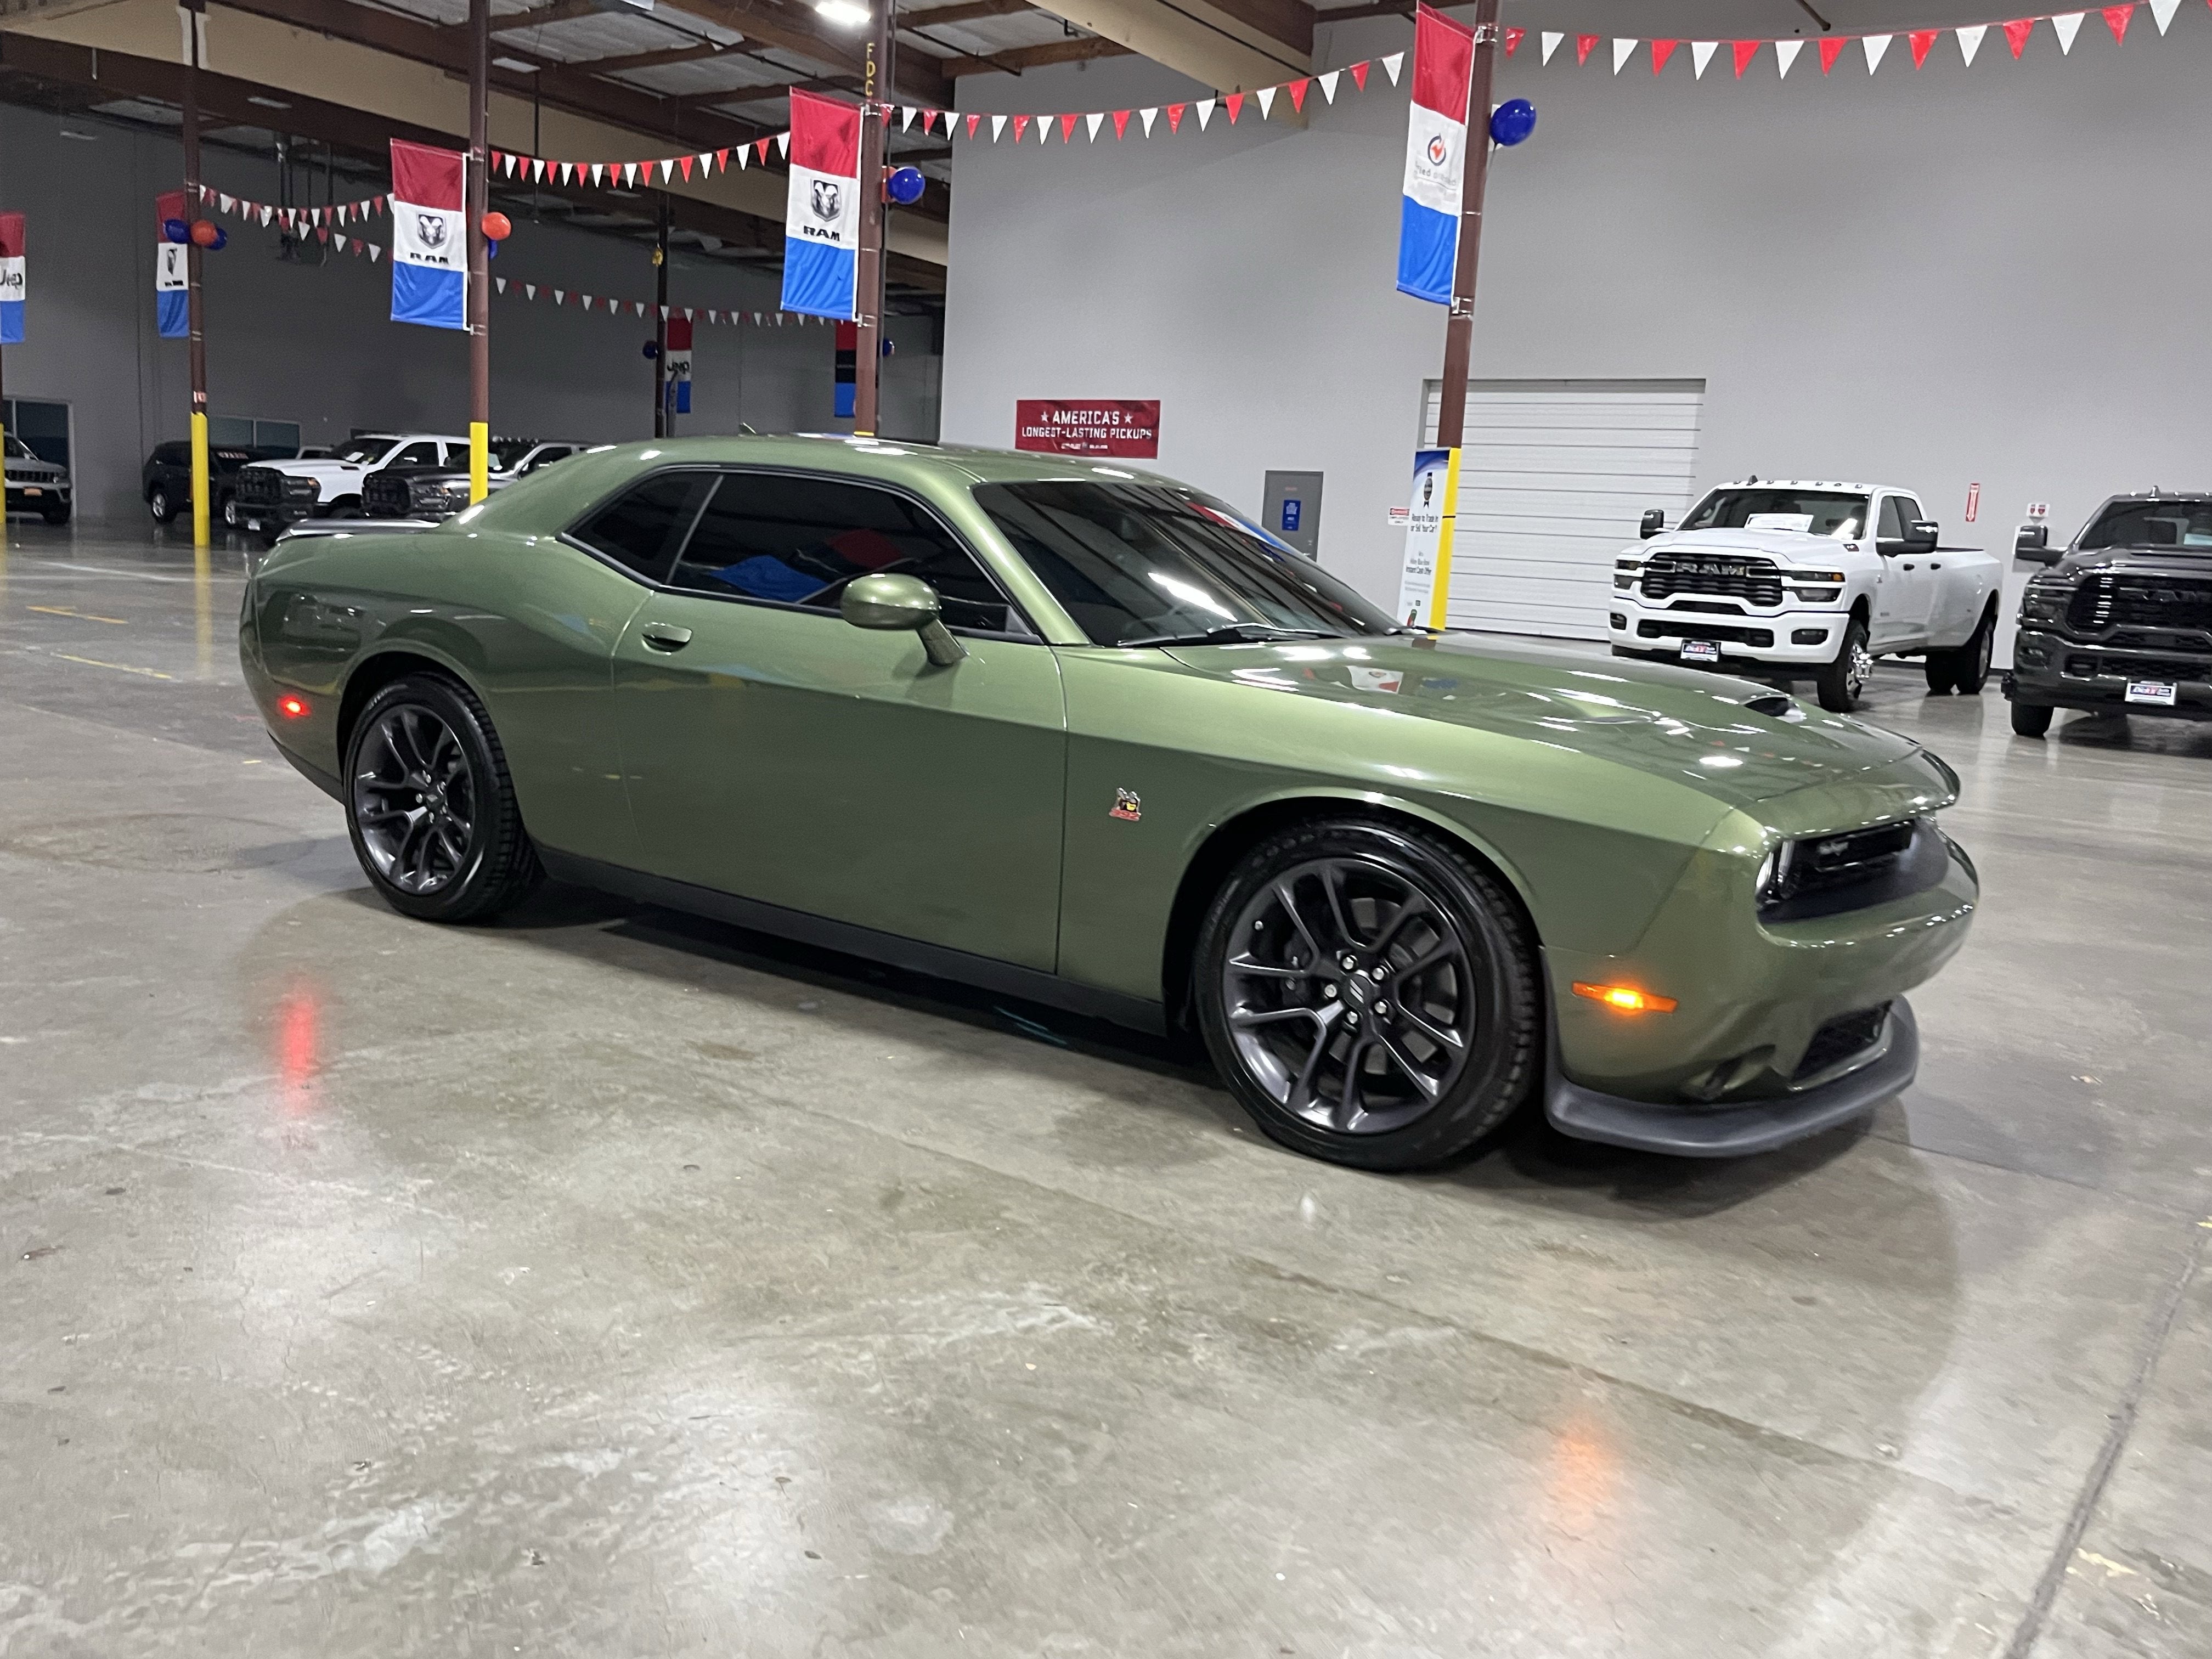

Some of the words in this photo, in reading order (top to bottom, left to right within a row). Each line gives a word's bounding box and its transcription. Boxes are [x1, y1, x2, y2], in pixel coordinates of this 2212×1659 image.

[804, 225, 840, 242] RAM
[1052, 410, 1120, 425] AMERICA'S
[1022, 426, 1107, 438] LONGEST-LASTING
[1109, 428, 1152, 439] PICKUPS
[1676, 561, 1745, 576] RAM
